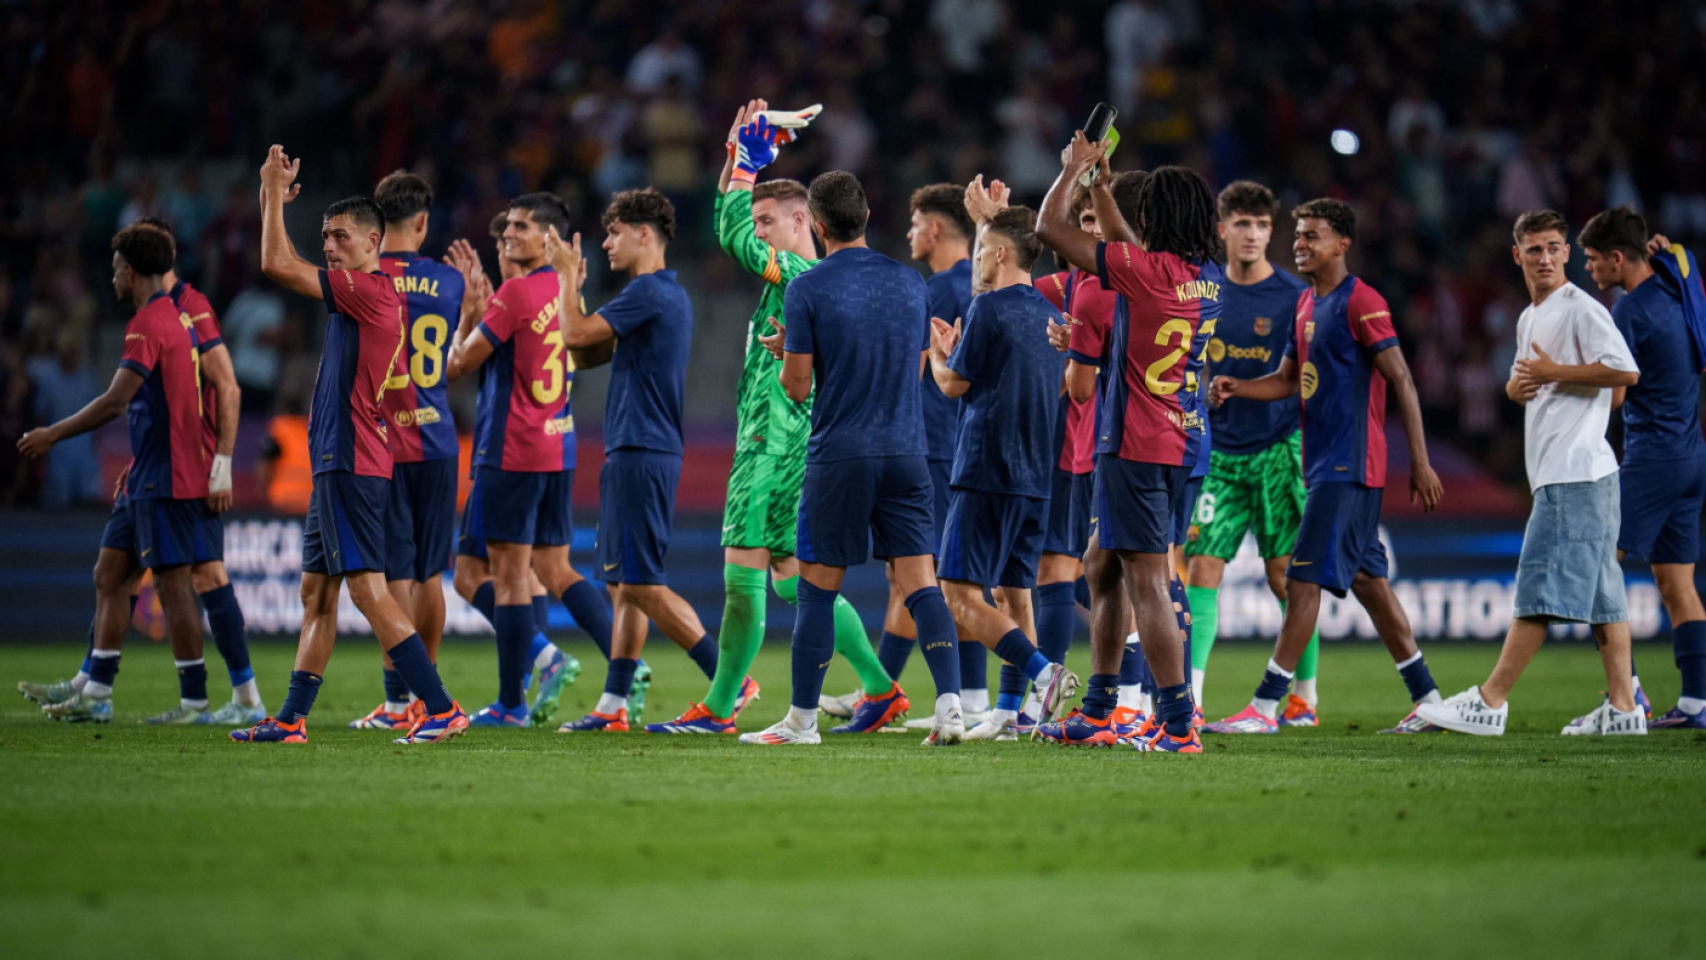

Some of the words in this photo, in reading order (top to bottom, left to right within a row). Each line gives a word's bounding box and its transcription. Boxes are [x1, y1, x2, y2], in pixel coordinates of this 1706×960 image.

[393, 276, 439, 298] RNAL
[1176, 281, 1221, 302] KOUNDE
[1227, 344, 1272, 363] Spotify
[1191, 492, 1216, 524] 6
